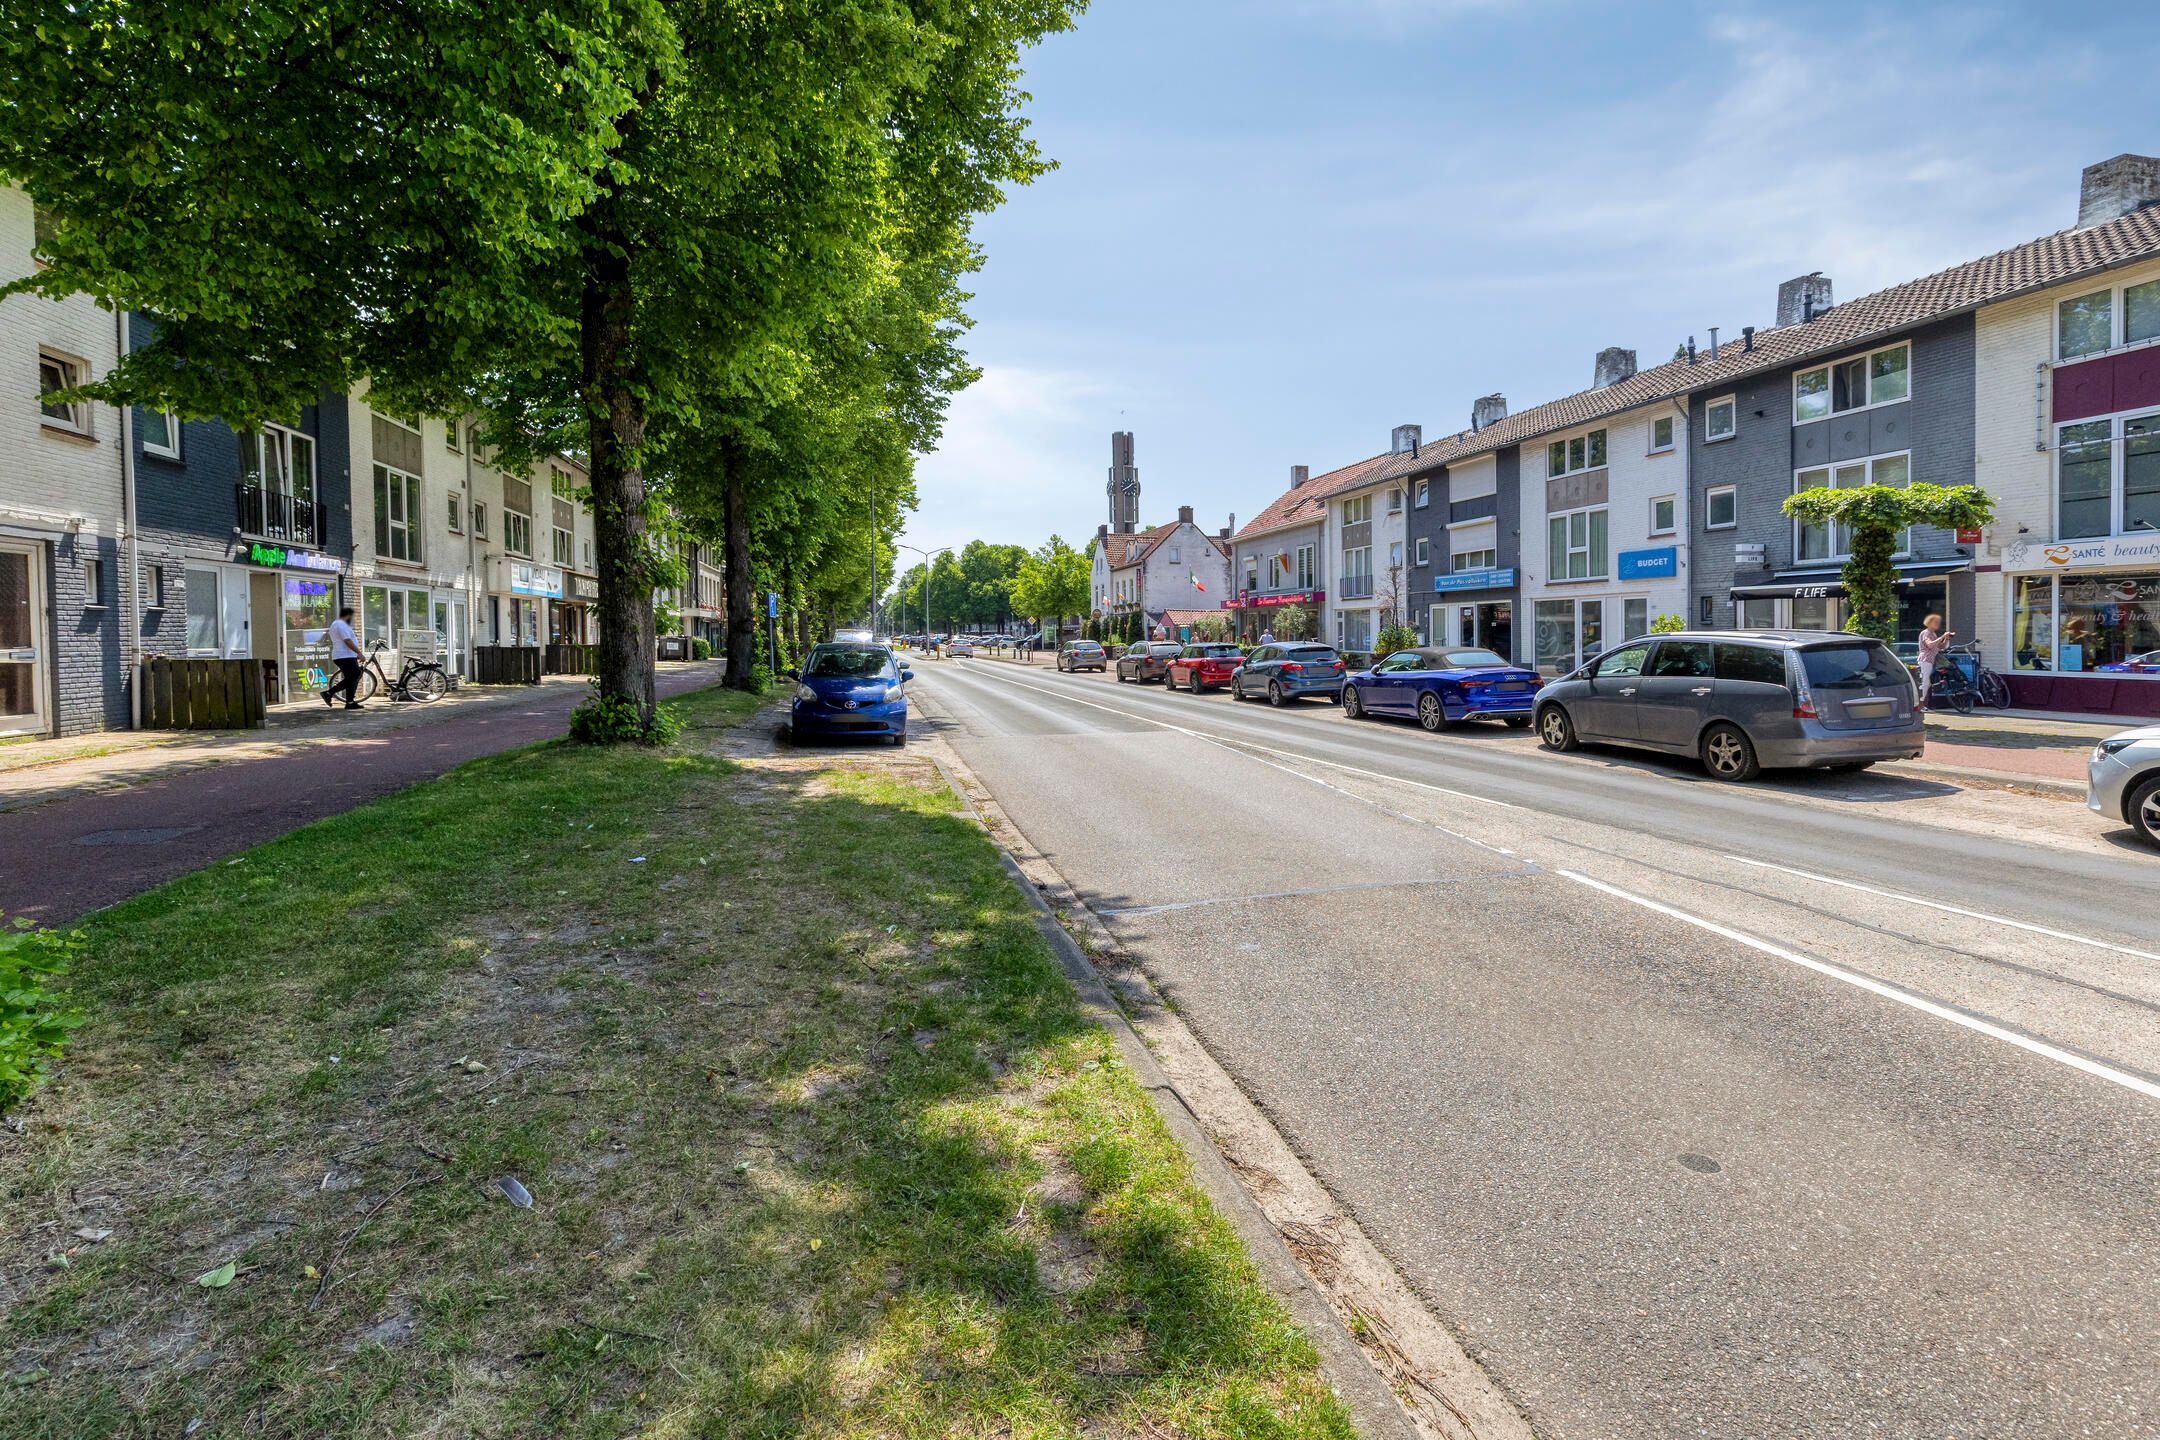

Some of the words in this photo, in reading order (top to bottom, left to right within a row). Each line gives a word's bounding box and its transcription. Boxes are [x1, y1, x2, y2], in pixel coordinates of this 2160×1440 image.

[252, 543, 286, 567] Apple
[1637, 557, 1668, 568] BUDGET
[1795, 588, 1803, 598] F
[1804, 586, 1828, 598] LIFE
